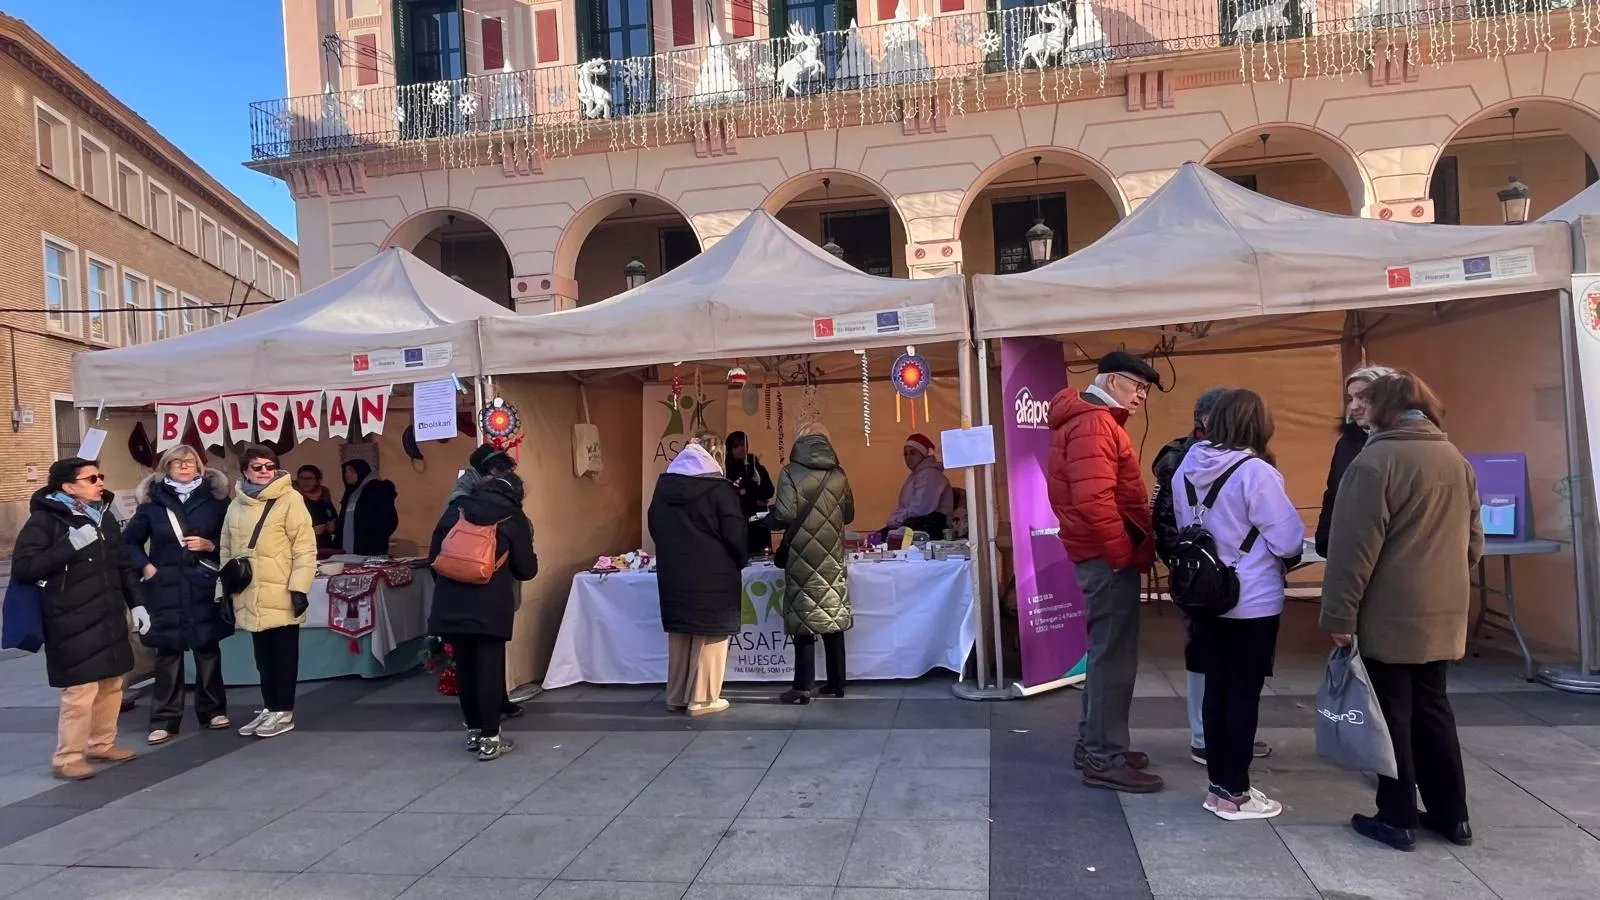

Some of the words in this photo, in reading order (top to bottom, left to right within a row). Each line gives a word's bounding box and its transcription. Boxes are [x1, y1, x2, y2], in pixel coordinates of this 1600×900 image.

[162, 394, 384, 441] BOLSKAN
[1015, 392, 1051, 429] afape
[738, 654, 786, 666] HUESCA
